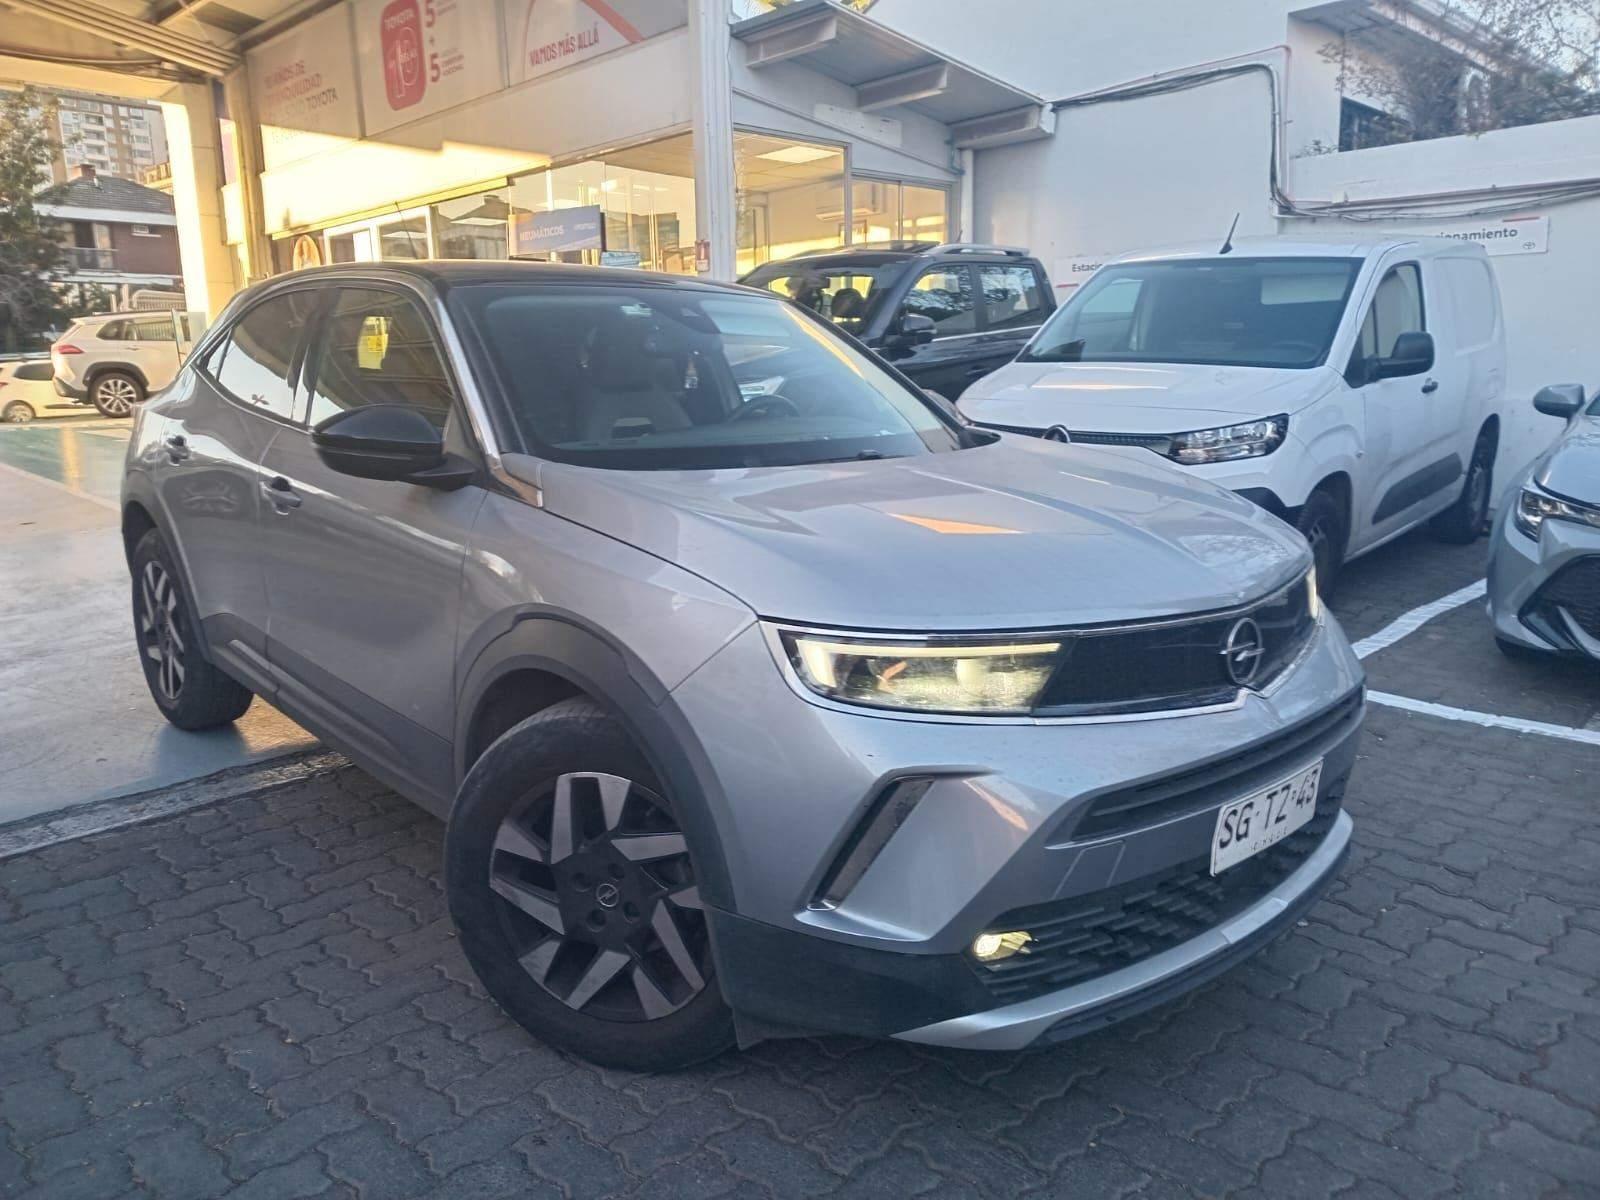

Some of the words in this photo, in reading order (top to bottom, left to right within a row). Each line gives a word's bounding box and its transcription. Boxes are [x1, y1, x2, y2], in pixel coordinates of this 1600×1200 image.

[530, 43, 557, 66] VAMOS
[558, 32, 576, 57] MÁS
[430, 52, 441, 83] 5
[306, 87, 339, 110] TOYOTA
